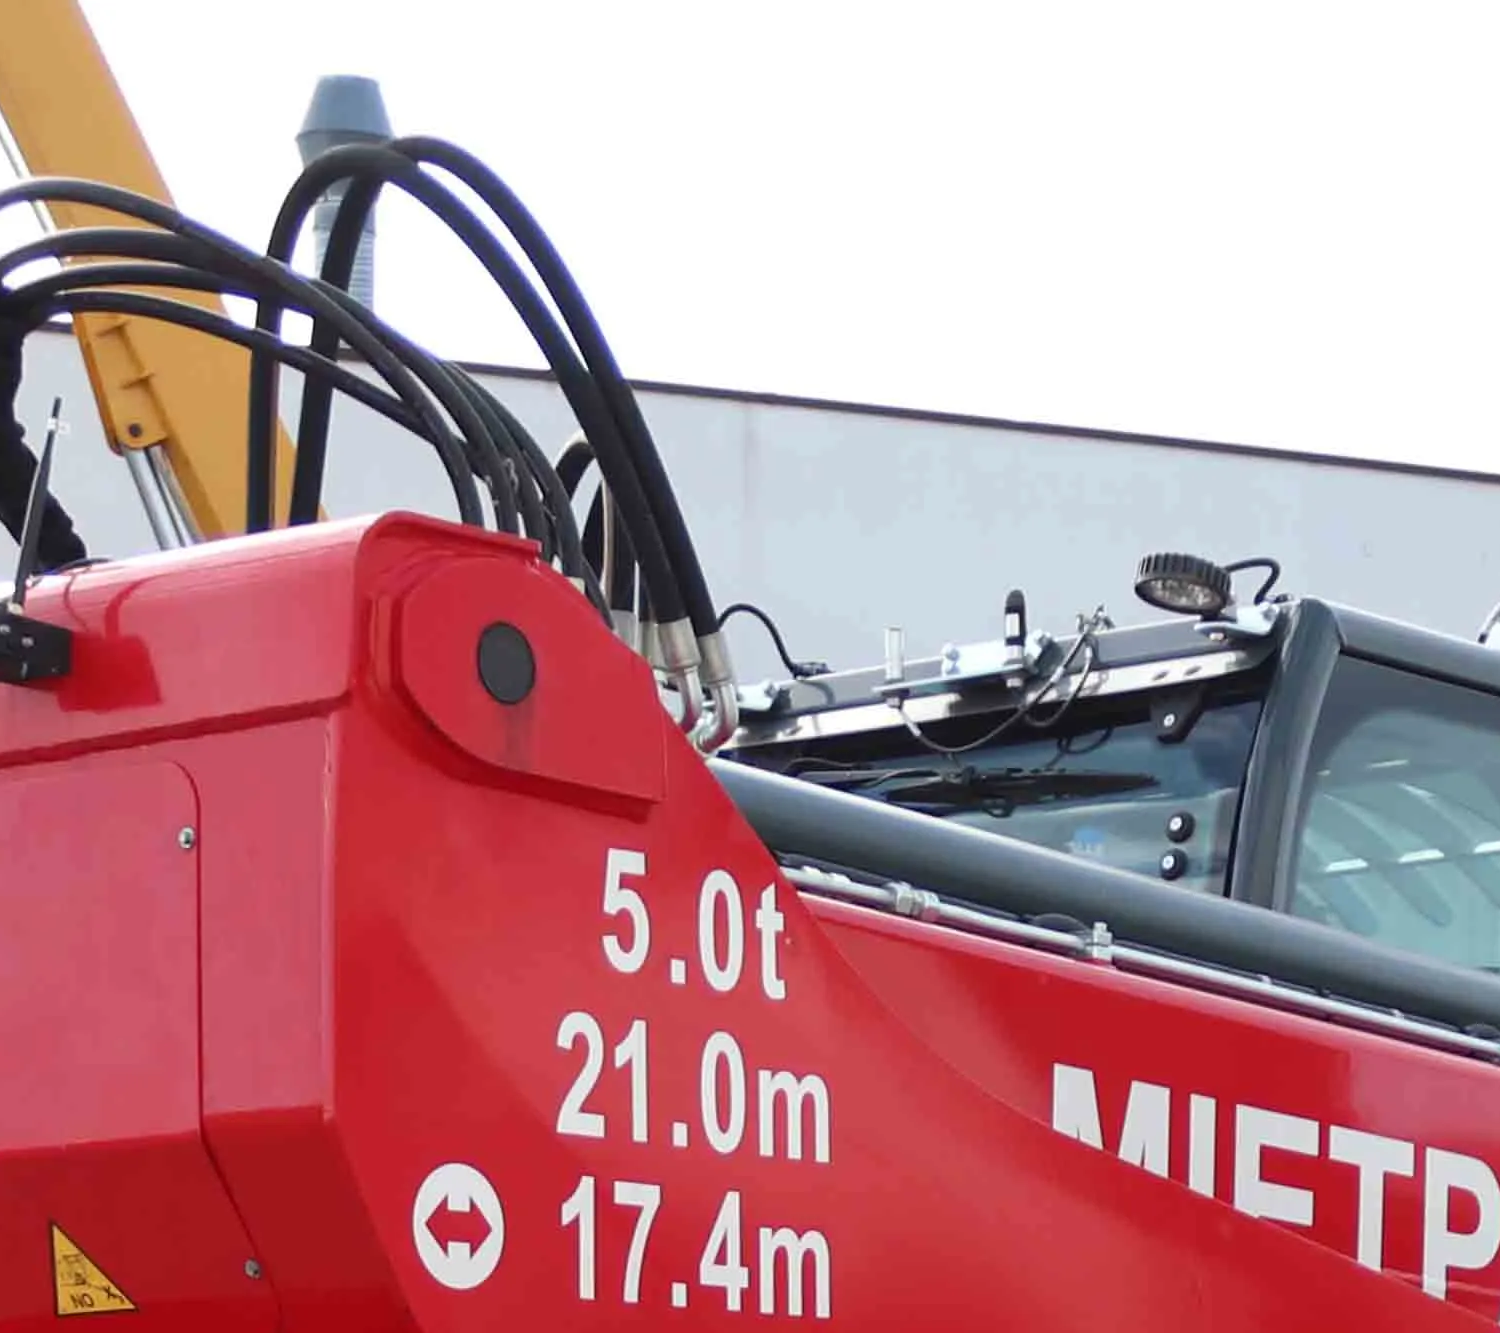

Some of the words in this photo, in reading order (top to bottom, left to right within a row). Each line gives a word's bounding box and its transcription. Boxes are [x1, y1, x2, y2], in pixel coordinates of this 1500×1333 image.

[602, 849, 788, 1001] 5.0t
[555, 1012, 832, 1163] 21.0m
[560, 1175, 832, 1319] 17.4m
